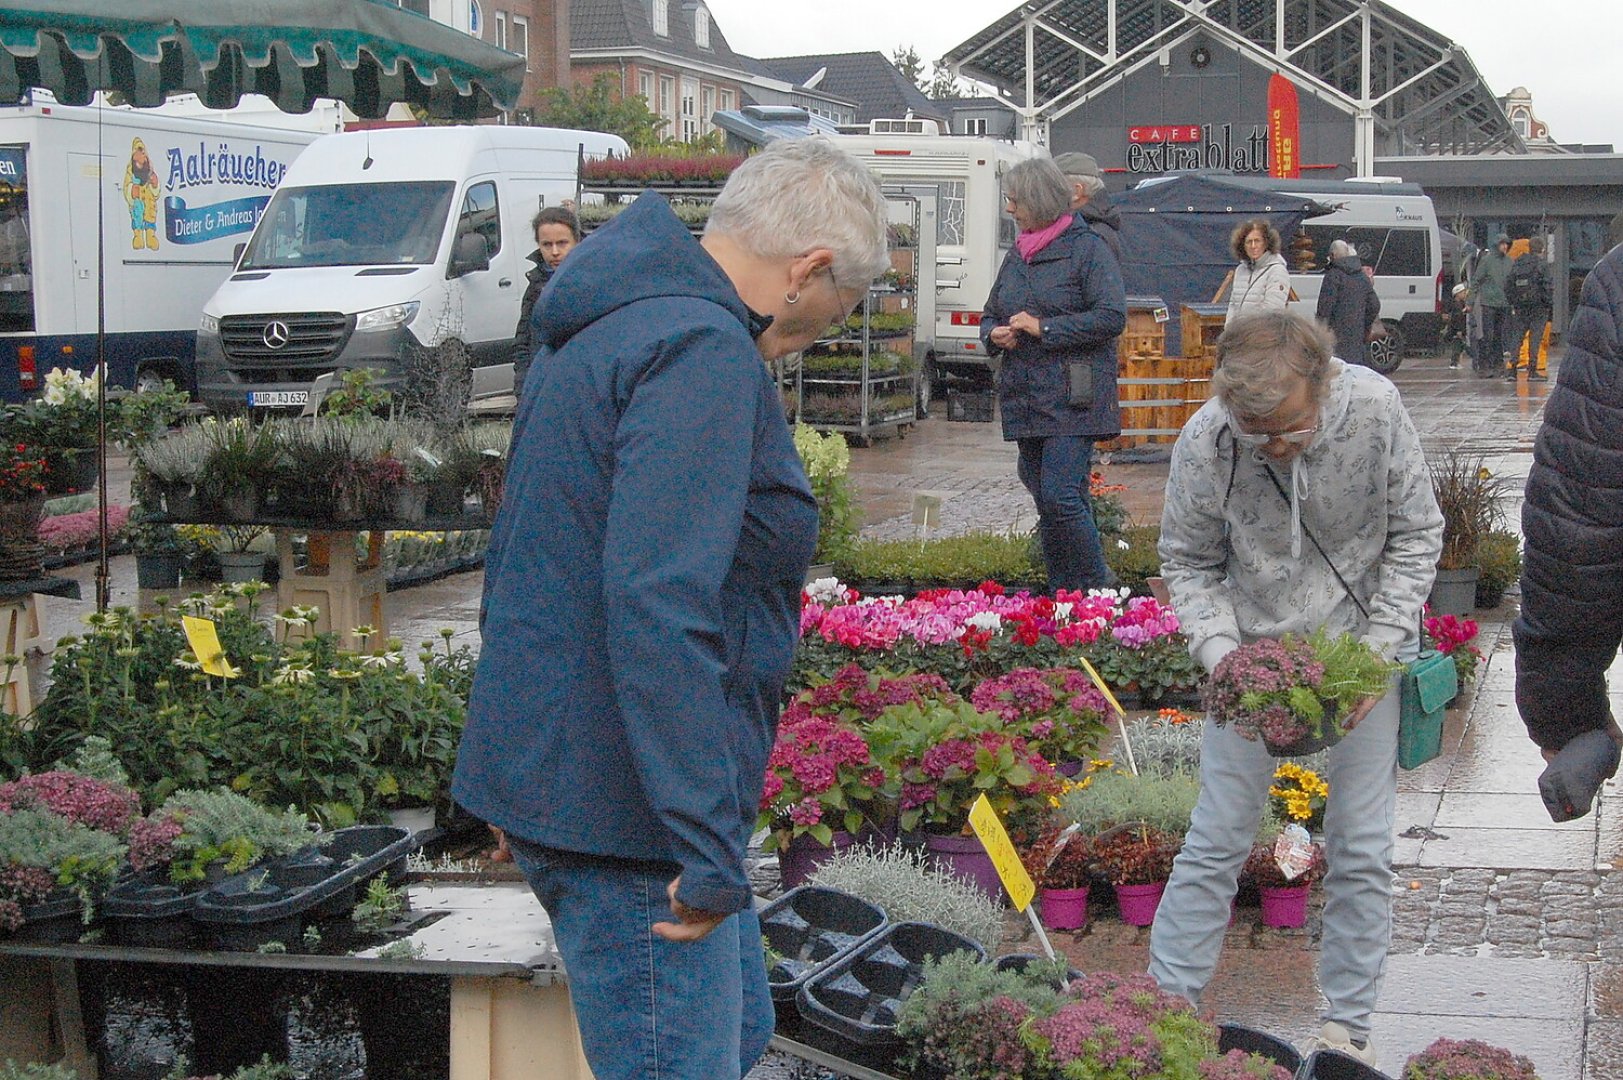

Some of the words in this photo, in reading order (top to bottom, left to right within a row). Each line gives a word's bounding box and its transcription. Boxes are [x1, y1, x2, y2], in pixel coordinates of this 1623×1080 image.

[1130, 128, 1197, 140] CAFE
[1126, 123, 1270, 173] extrablatt
[175, 218, 203, 236] Dieter
[205, 213, 214, 230] &
[217, 208, 253, 228] Andreas
[254, 393, 271, 404] AUR
[290, 392, 307, 403] 632
